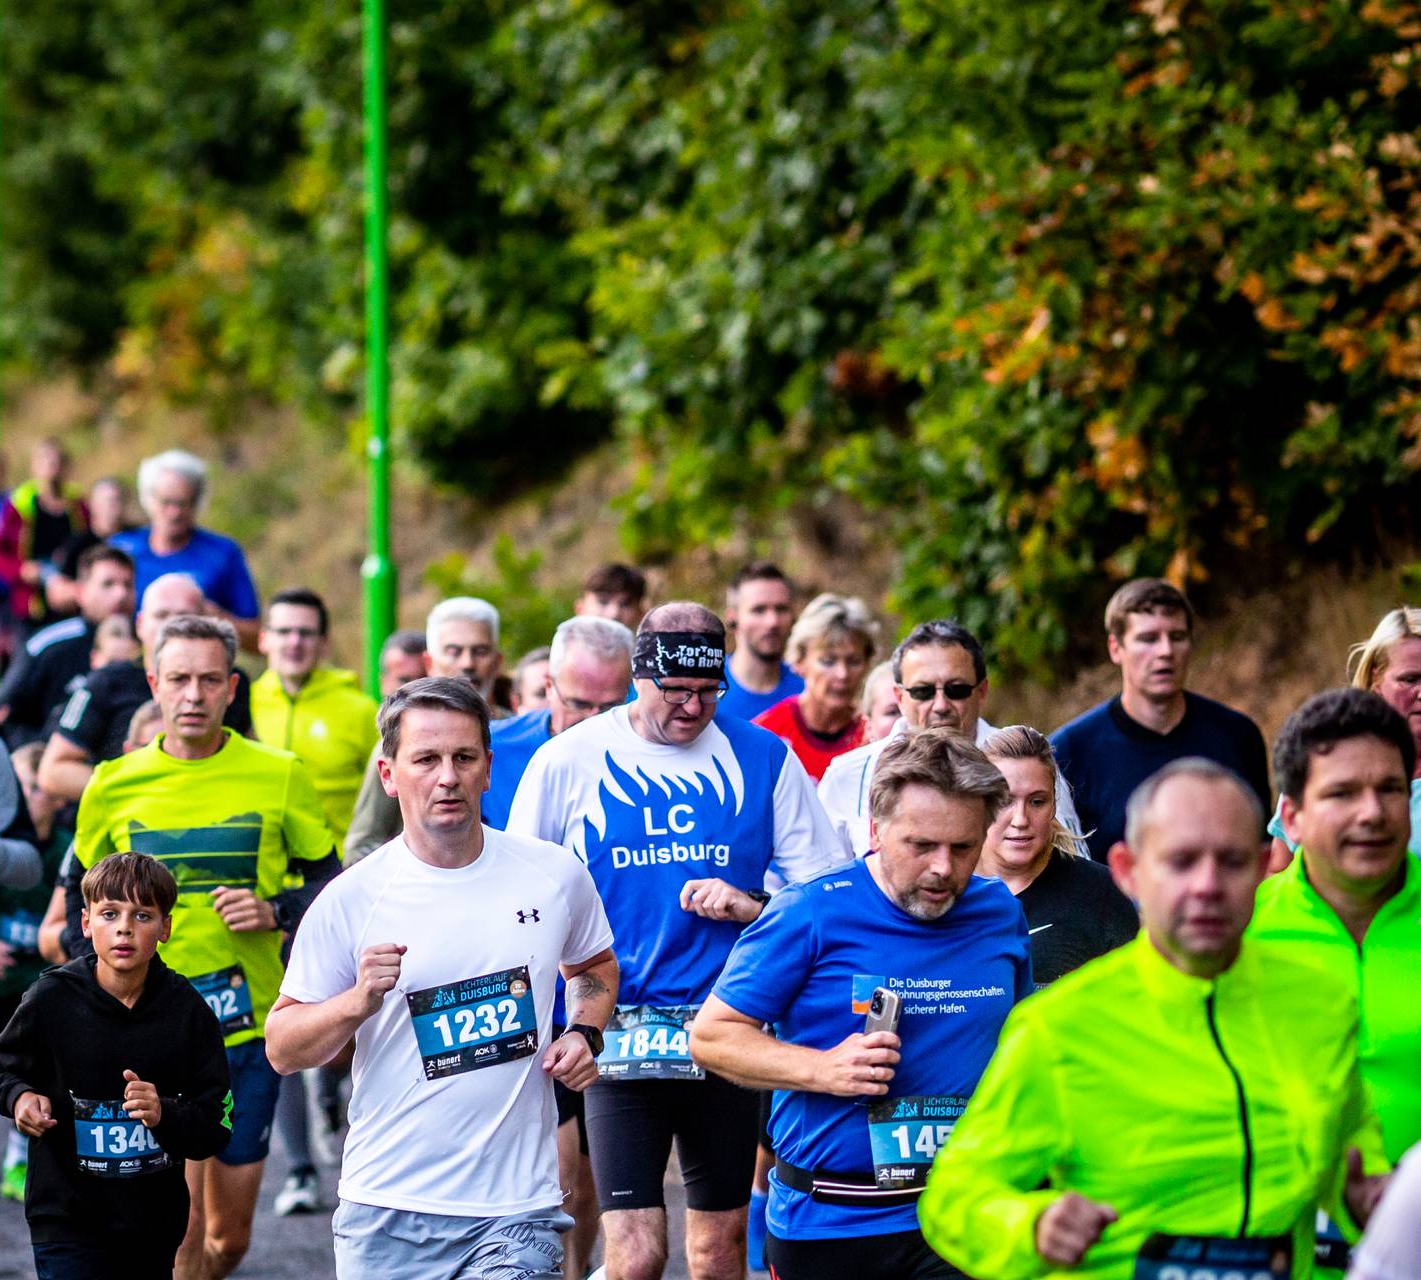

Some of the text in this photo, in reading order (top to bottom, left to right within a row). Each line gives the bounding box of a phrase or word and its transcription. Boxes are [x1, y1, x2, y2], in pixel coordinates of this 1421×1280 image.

[643, 804, 695, 836] LC
[611, 842, 730, 869] Duisburg
[459, 973, 508, 991] LICHTERLAUF
[889, 977, 952, 991] Die Duisburger
[460, 982, 508, 1002] DUISBURG
[904, 1003, 967, 1015] sicherer Hafen.
[433, 999, 521, 1047] 1232
[474, 1046, 490, 1056] AOK
[617, 1028, 689, 1058] 1844
[922, 1106, 965, 1117] DUISBUR
[119, 1160, 134, 1168] AOK
